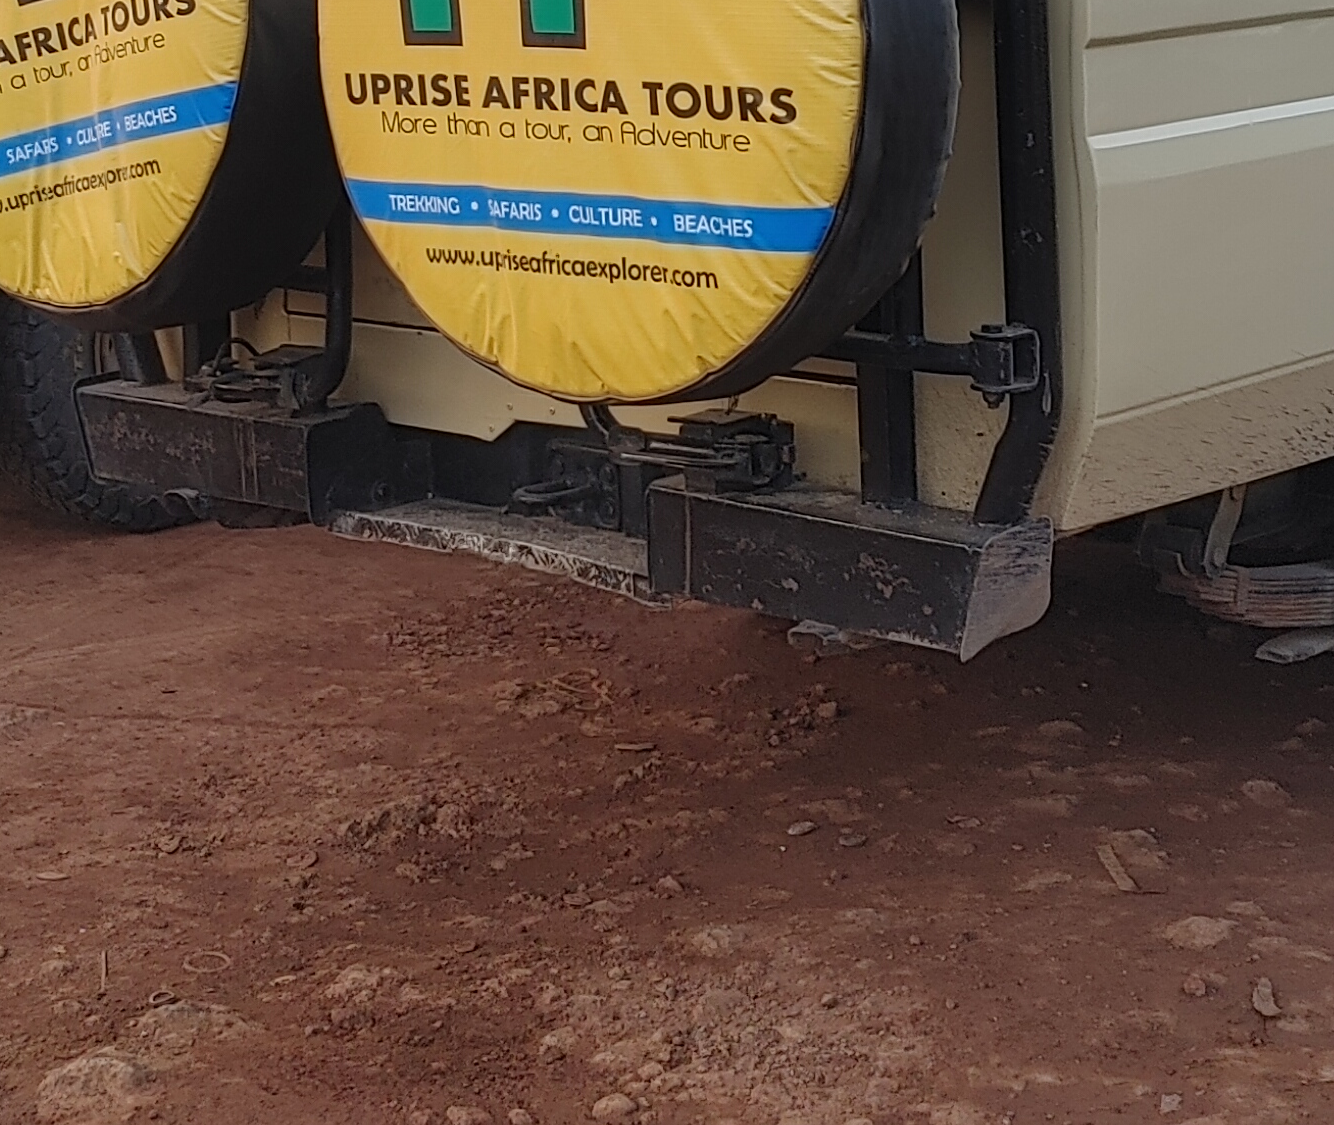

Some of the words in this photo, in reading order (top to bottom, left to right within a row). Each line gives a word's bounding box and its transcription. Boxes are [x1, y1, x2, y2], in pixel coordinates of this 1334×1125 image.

[10, 71, 26, 90] a
[33, 60, 73, 84] tour,
[123, 105, 178, 132] BEACHES
[344, 72, 471, 107] UPRISE
[481, 75, 629, 115] AFRICA
[641, 81, 798, 125] TOURS
[381, 110, 438, 135] More
[447, 112, 490, 138] than
[499, 121, 516, 139] a
[525, 118, 572, 144] tour,
[583, 124, 613, 143] an
[621, 120, 751, 152] Adventure
[389, 193, 461, 215] TREKKING
[487, 199, 542, 221] SAFARIS
[568, 205, 644, 228] CULTURE
[673, 213, 754, 239] BEACHES
[426, 247, 719, 289] www.upriseafricaexplorer.com
